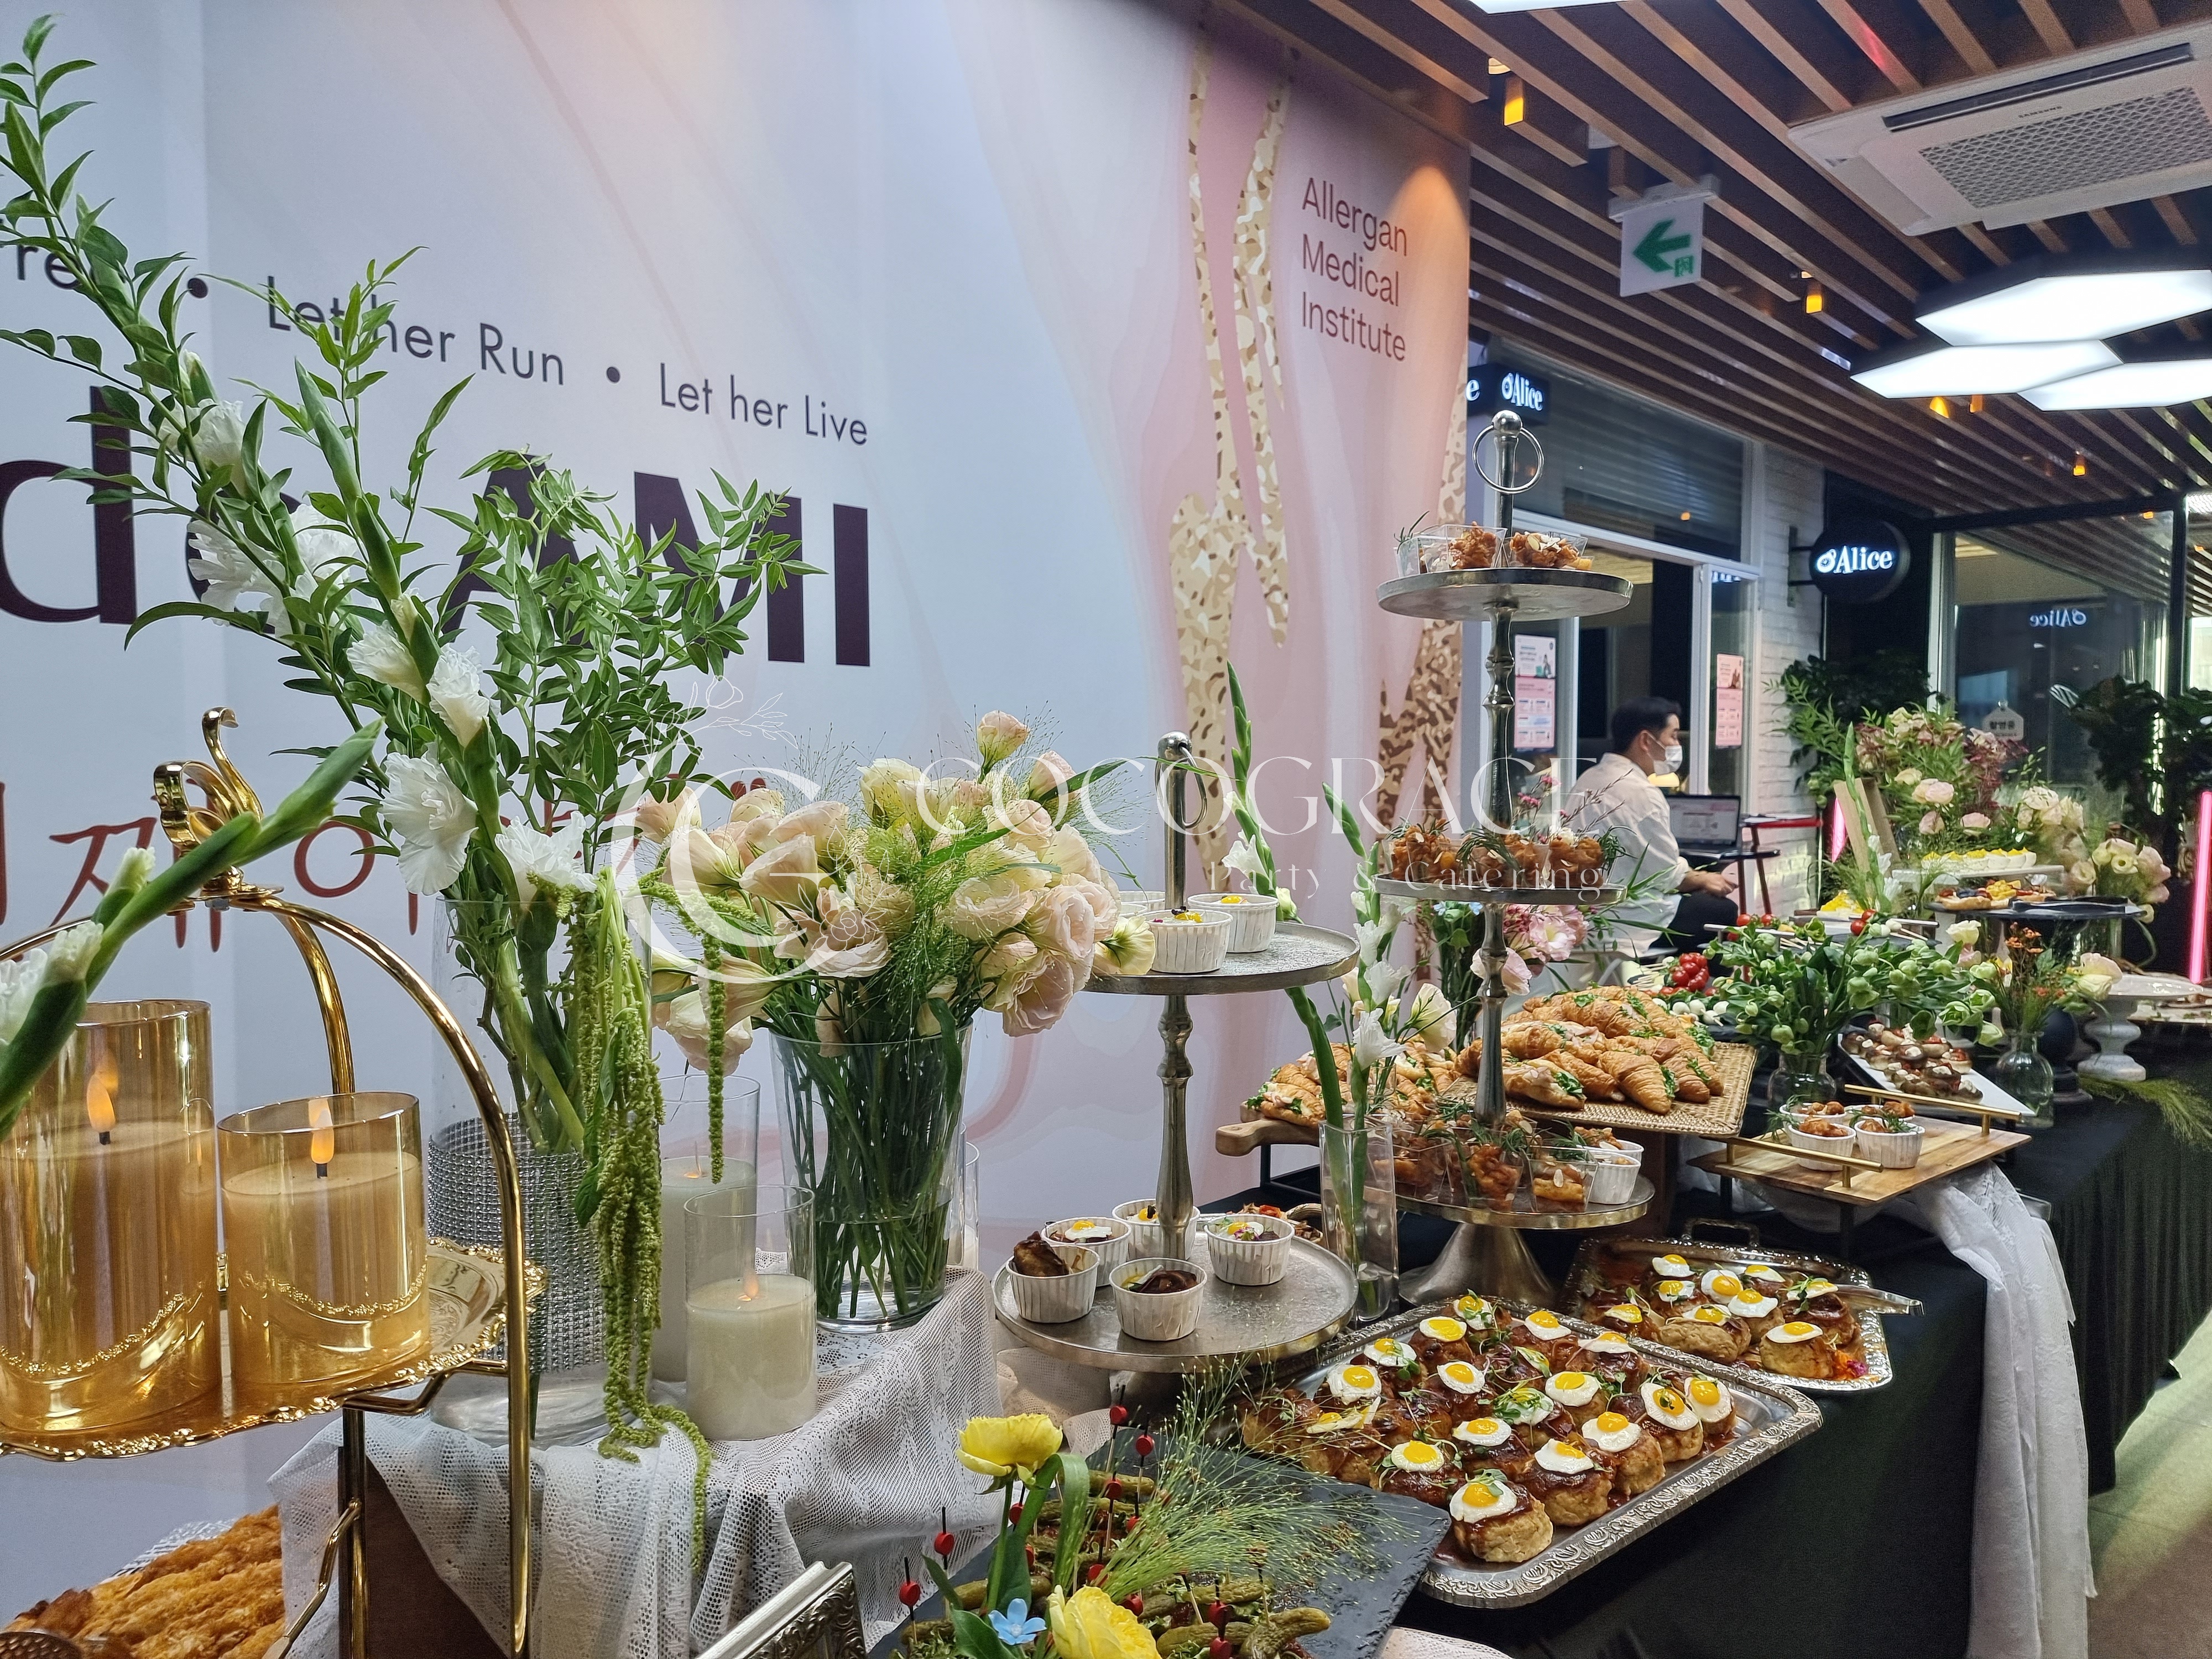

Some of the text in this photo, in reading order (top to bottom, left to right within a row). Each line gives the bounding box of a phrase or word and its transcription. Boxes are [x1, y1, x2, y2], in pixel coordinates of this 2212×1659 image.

[1302, 177, 1407, 257] Allergan
[1303, 233, 1399, 306] Medical
[268, 275, 345, 341] Let
[479, 322, 564, 385] Run
[660, 362, 712, 414] Let
[730, 374, 788, 429] her
[805, 394, 868, 446] Live
[1302, 291, 1406, 361] Institute
[1510, 372, 1543, 411] Alice
[1833, 545, 1893, 574] Alice
